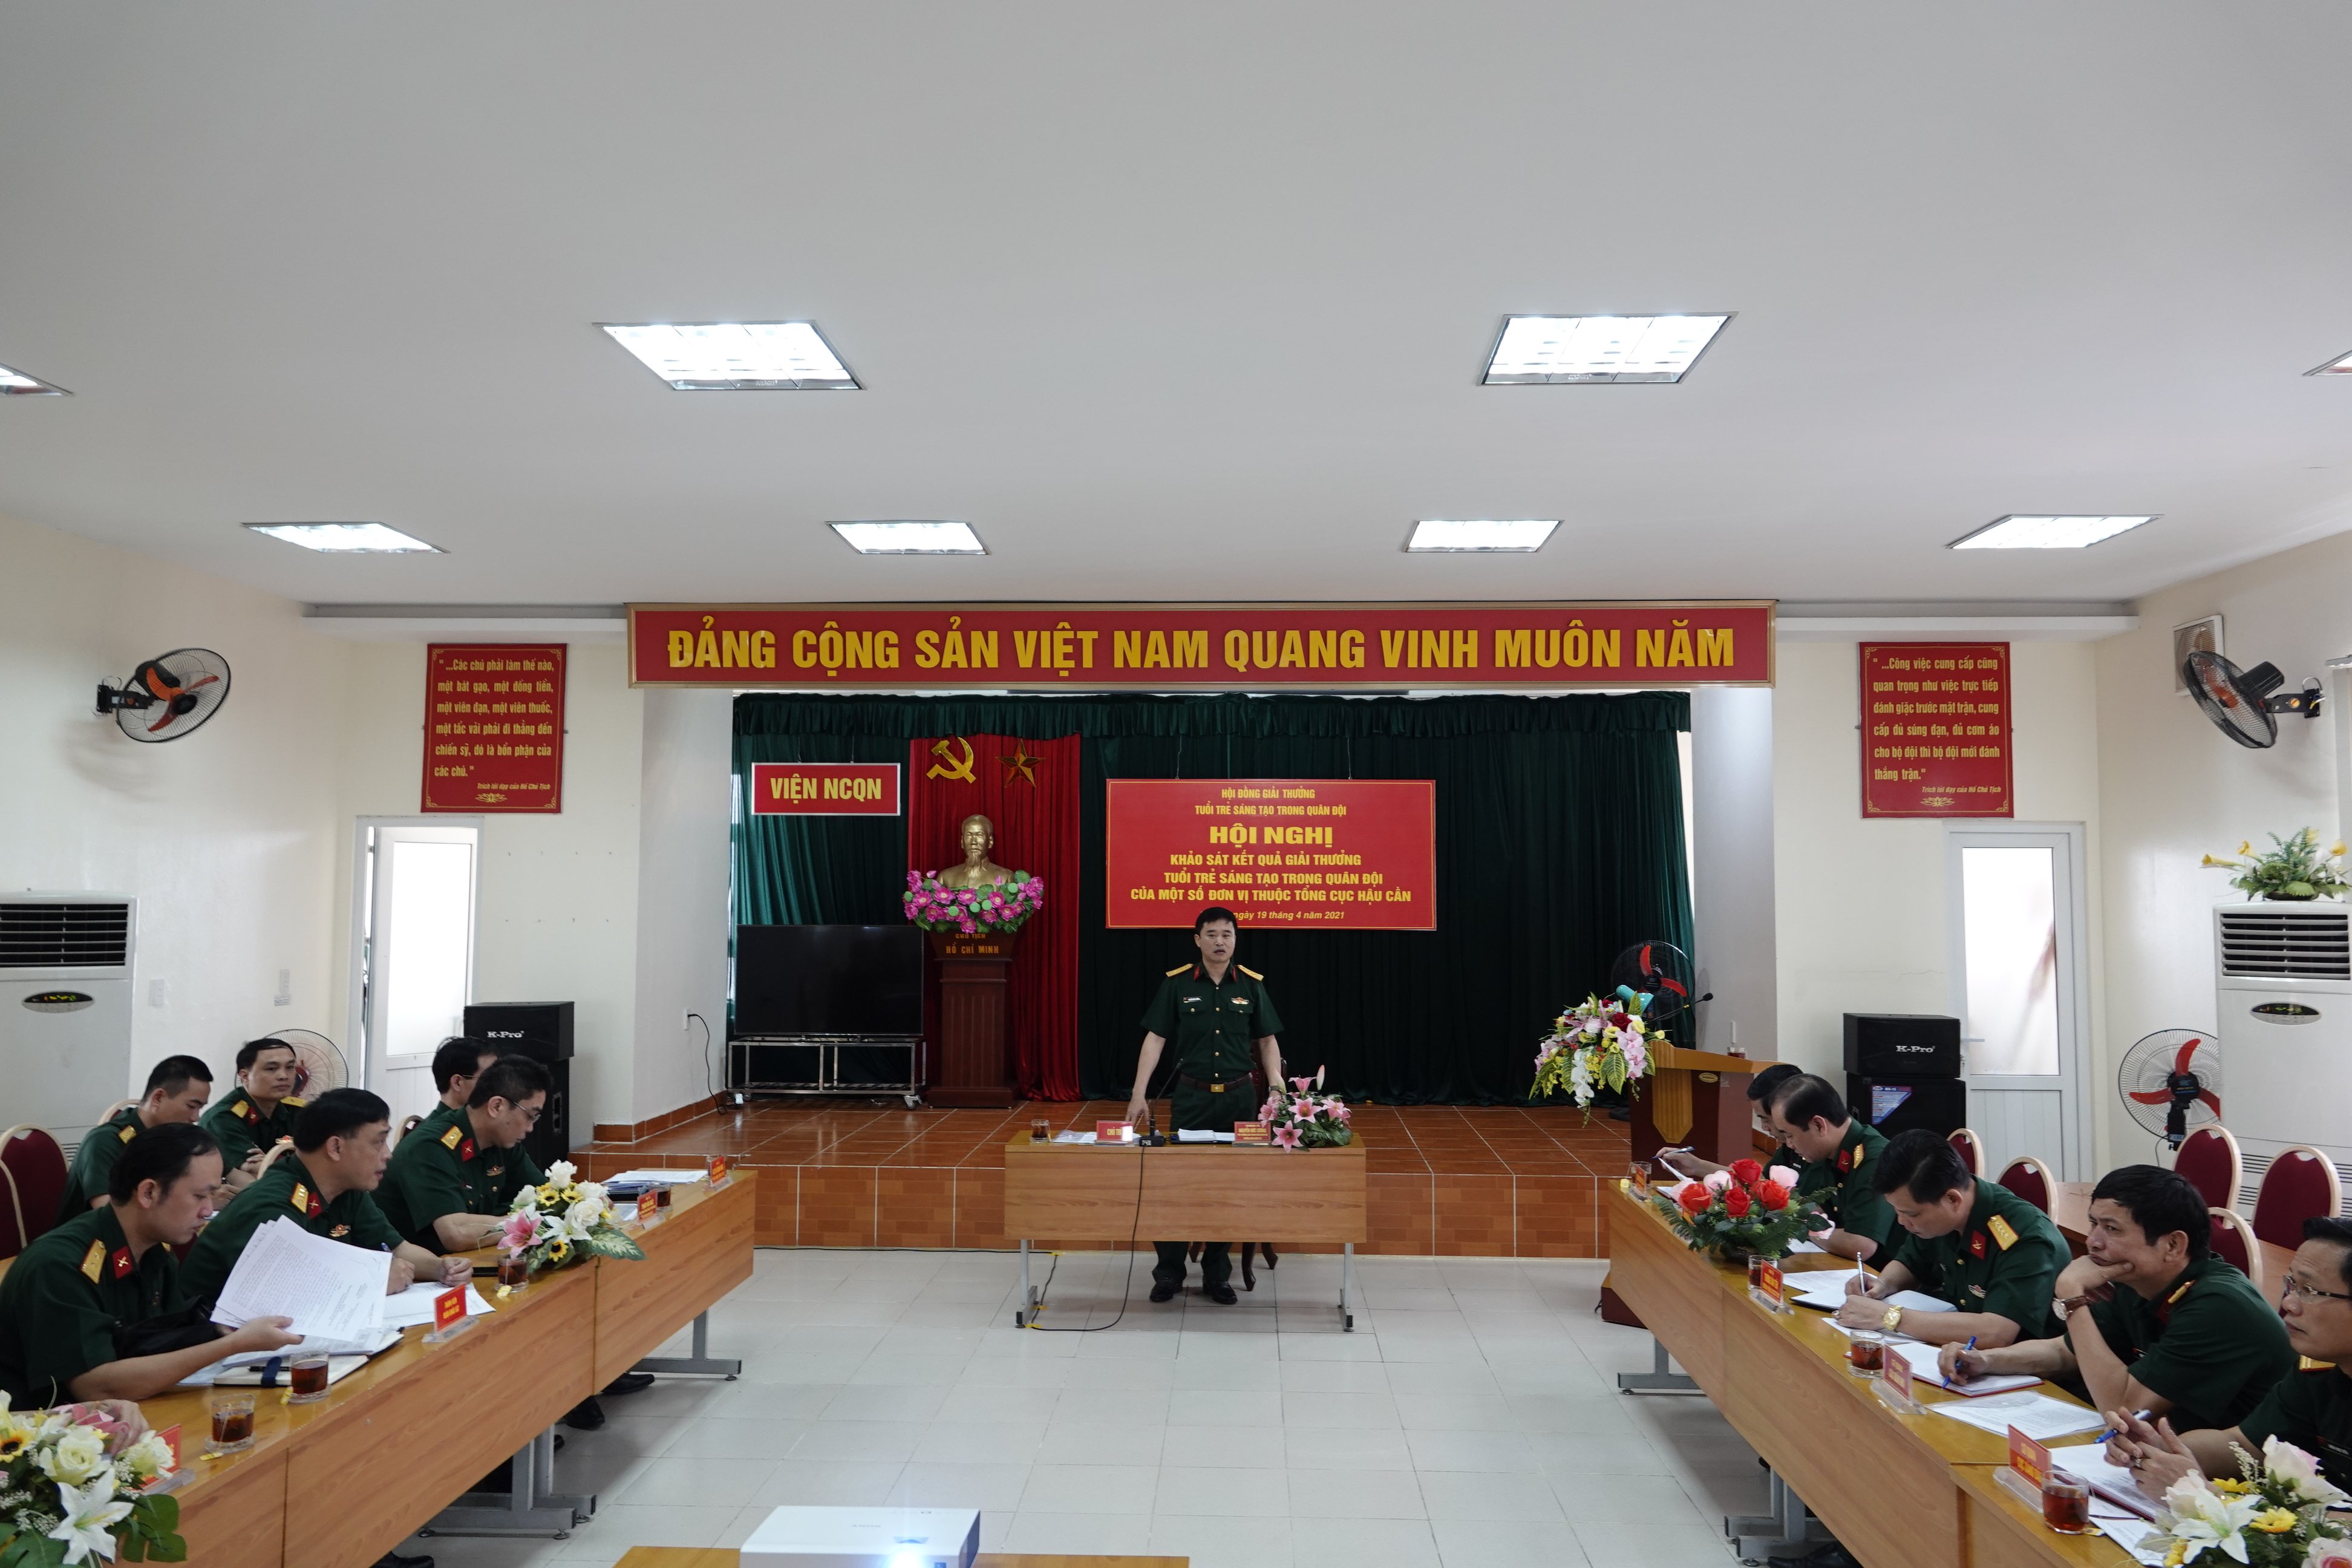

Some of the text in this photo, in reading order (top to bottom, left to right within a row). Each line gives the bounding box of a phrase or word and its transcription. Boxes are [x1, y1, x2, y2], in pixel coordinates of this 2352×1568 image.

[668, 616, 1734, 676] ĐẢNG CỘNG SẢN VIỆT NAM QUANG VINH MUÔN NĂM
[469, 659, 485, 671] chú
[486, 658, 504, 672] phải
[506, 659, 521, 671] làm
[523, 658, 536, 671] thế
[537, 659, 554, 671] nào,
[1881, 657, 1910, 671] ...Công
[1913, 657, 1932, 671] việc
[1934, 659, 1955, 670] cung
[1958, 655, 1974, 670] cấp
[1977, 657, 1998, 670] cũng
[437, 678, 554, 694] một bát gạo, một đồng tiền,
[1873, 677, 1999, 694] quan trọng như việc trực tiếp
[437, 700, 553, 716] một viên đạn, một viên thuốc,
[1873, 701, 1999, 716] đánh giặc trước mặt trận, cung
[436, 720, 552, 737] một tấc vải phải đi thẳng đến
[1873, 721, 2000, 738] cấp đủ súng đạn, đủ cơm áo
[435, 742, 552, 758] chiến sỹ, đó là bổn phận của
[1874, 745, 2000, 760] cho bộ đội thì bộ đội mới đánh
[434, 765, 449, 777] các
[1874, 766, 1898, 782] thắng
[771, 774, 881, 803] VIỆN NCQN
[1221, 785, 1315, 800] HỘI ĐỒNG GIẢI THƯỞNG
[1989, 786, 2002, 794] Tịch
[1195, 800, 1347, 817] TUỔI TRẺ SÁNG TẠO TRONG QUÂN ĐỘI
[1210, 823, 1332, 848] HỘI NGHỊ
[1170, 850, 1361, 866] KHẢO SÁT KẾT QUẢ GIẢI THƯỞNG
[1164, 867, 1383, 886] TUỔI TRẺ SÁNG TẠO TRONG QUÂN ĐỘI
[1131, 885, 1411, 904] CỦA MỘT SỐ ĐƠN VỊ THUỘC TỔNG CỤC HẬU CẦN
[1269, 911, 1294, 921] tháng
[1324, 911, 1345, 920] 2021
[946, 941, 999, 954] HỒ CHÍ MINH
